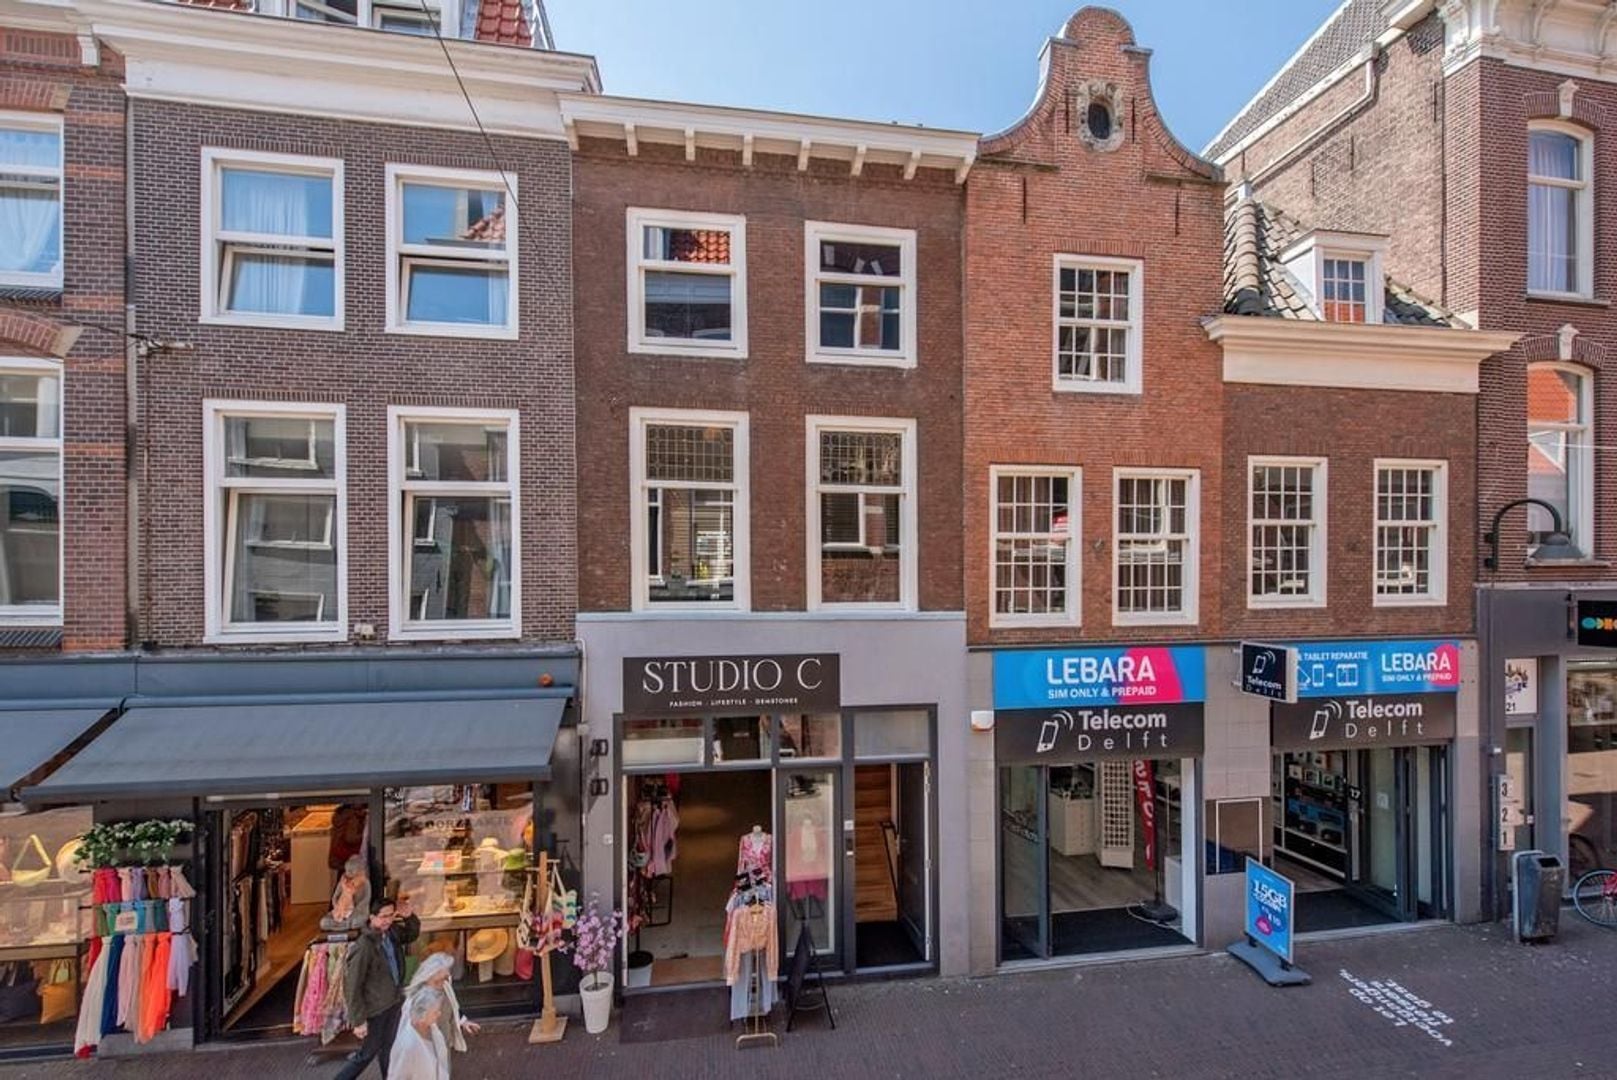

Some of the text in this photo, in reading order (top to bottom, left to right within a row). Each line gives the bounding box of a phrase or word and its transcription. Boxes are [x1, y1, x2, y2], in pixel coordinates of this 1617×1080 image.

[1304, 651, 1329, 661] TABLET
[1331, 650, 1368, 660] REPARATIE
[1381, 651, 1451, 672] LEBARA
[643, 658, 822, 693] STUDIO C
[1047, 656, 1156, 684] LEBARA
[1423, 672, 1452, 681] PREPAID
[1246, 675, 1282, 690] Telecom
[1048, 685, 1157, 699] SIM ONLY & PREPAID
[669, 700, 703, 708] FASHION
[710, 698, 746, 706] LIFESTYLE
[1346, 698, 1423, 719] Telecom
[1078, 709, 1167, 730] Telecom
[1345, 719, 1424, 739] Delft
[1078, 731, 1168, 751] Delft
[1501, 782, 1508, 797] 3
[1501, 807, 1508, 823] 2
[1502, 831, 1508, 845] 1
